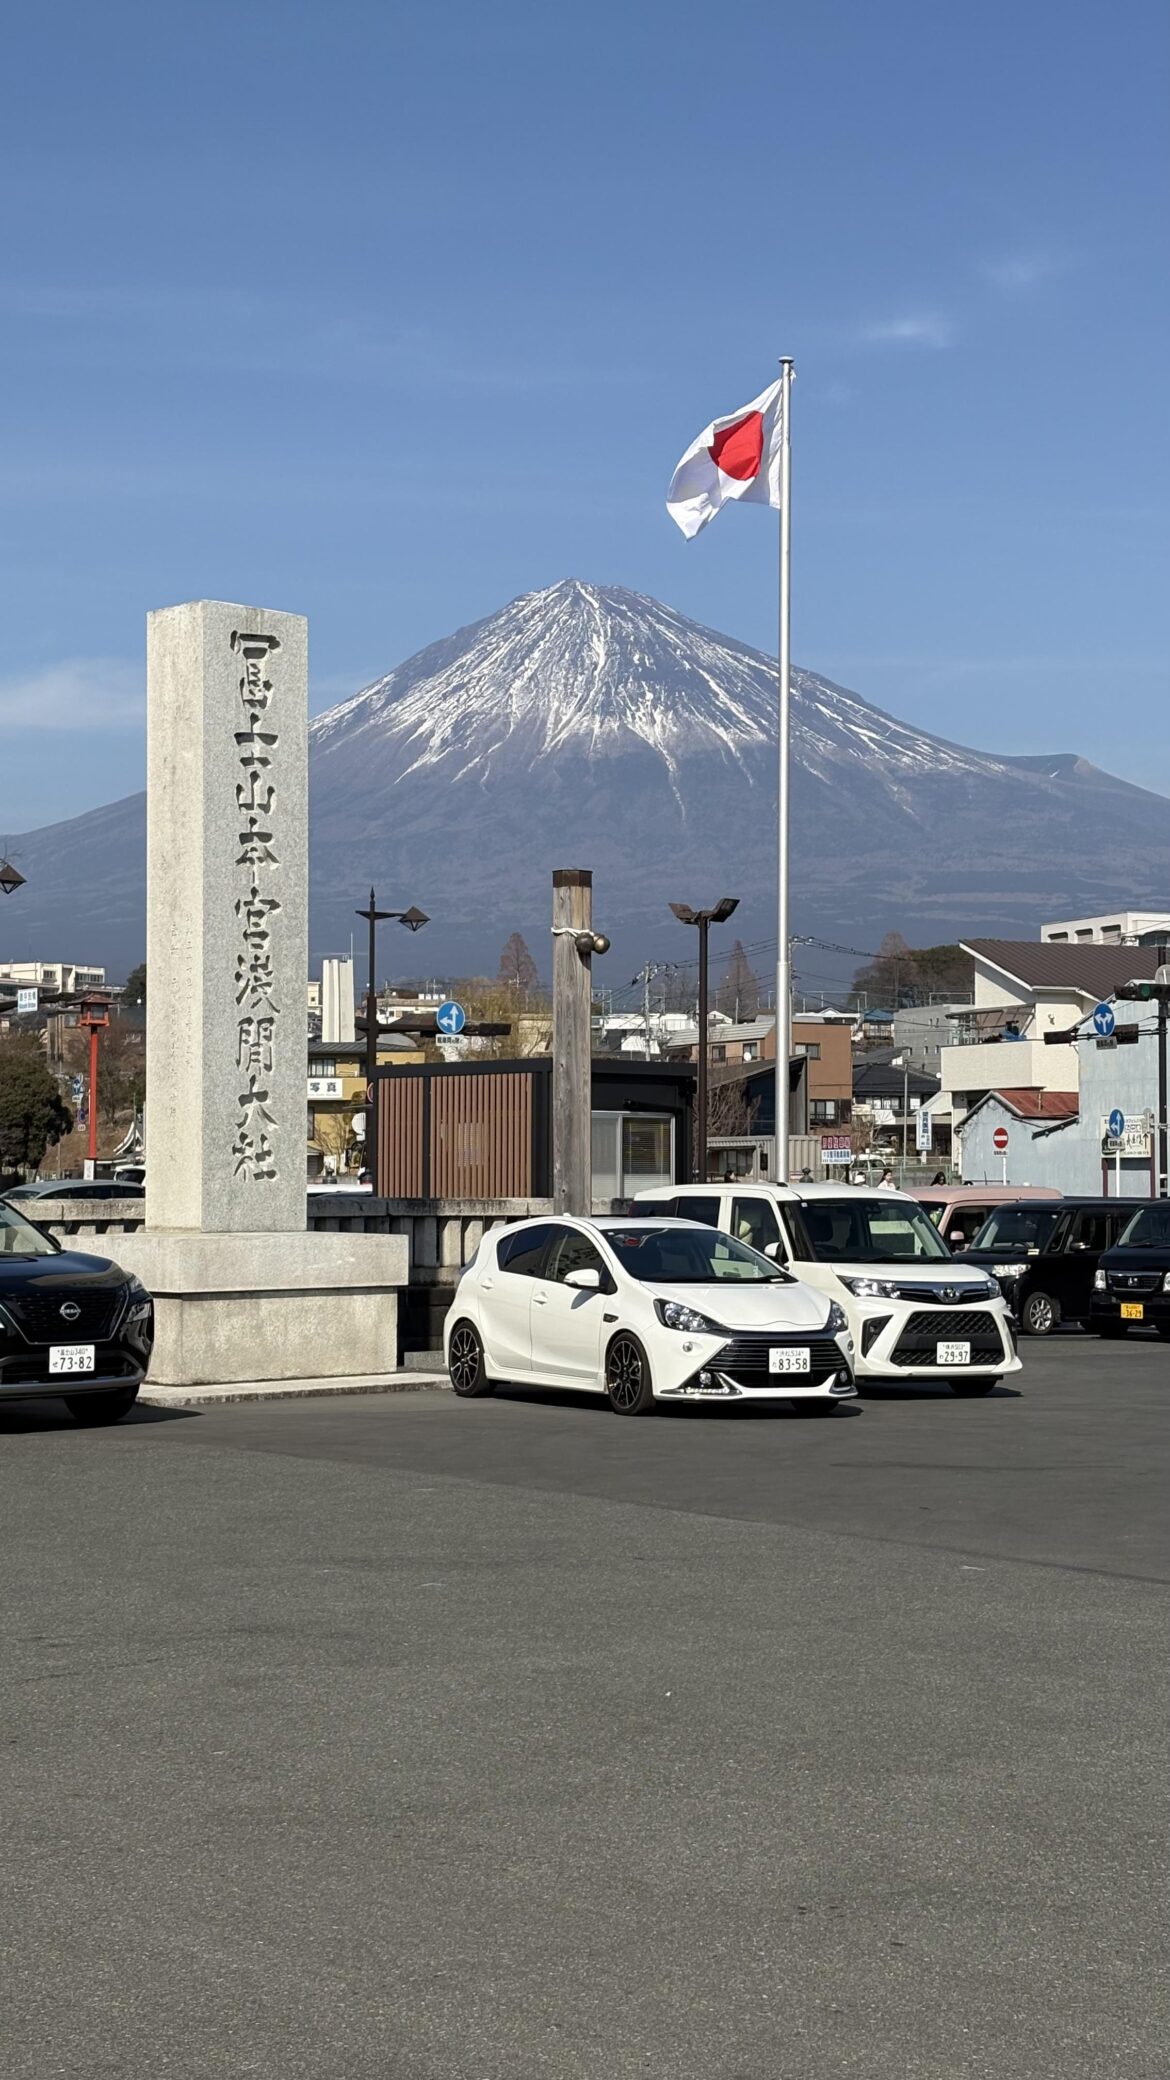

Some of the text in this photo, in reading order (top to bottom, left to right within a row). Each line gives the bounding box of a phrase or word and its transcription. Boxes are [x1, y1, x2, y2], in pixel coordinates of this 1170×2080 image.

[60, 1355, 92, 1371] 73-82
[944, 1350, 969, 1363] 29-97
[778, 1357, 808, 1371] 83-58
